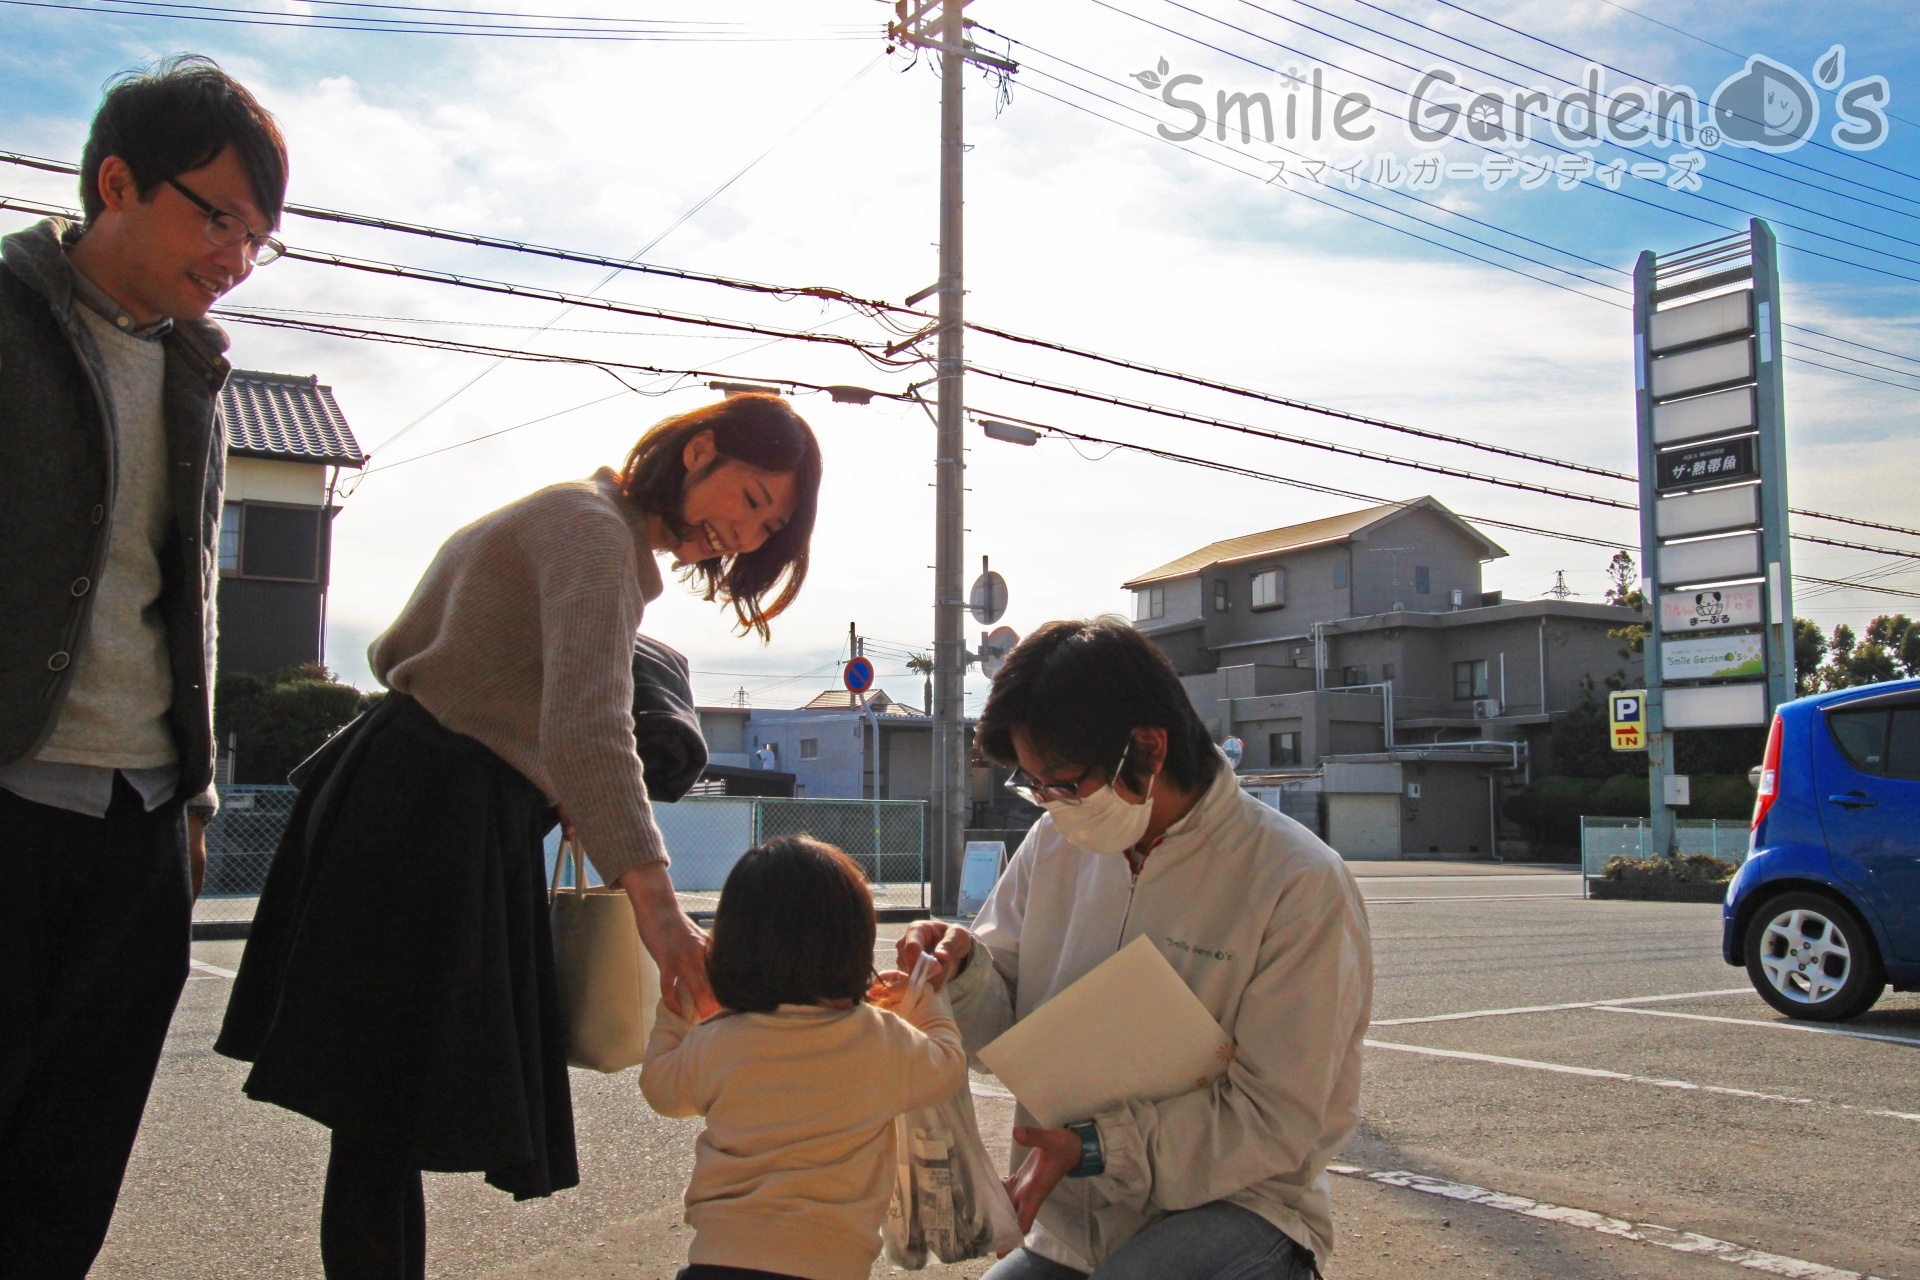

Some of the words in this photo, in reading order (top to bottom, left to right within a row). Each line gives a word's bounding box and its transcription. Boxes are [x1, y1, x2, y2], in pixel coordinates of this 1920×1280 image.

[1699, 448, 1725, 457] MONSTER
[1672, 455, 1737, 479] ザ・熱帯魚
[1689, 614, 1730, 626] まーぶる
[1668, 656, 1691, 666] Smile
[1694, 654, 1724, 664] Garden
[1616, 698, 1638, 721] P
[1617, 736, 1638, 746] IN
[1167, 938, 1190, 952] Smile
